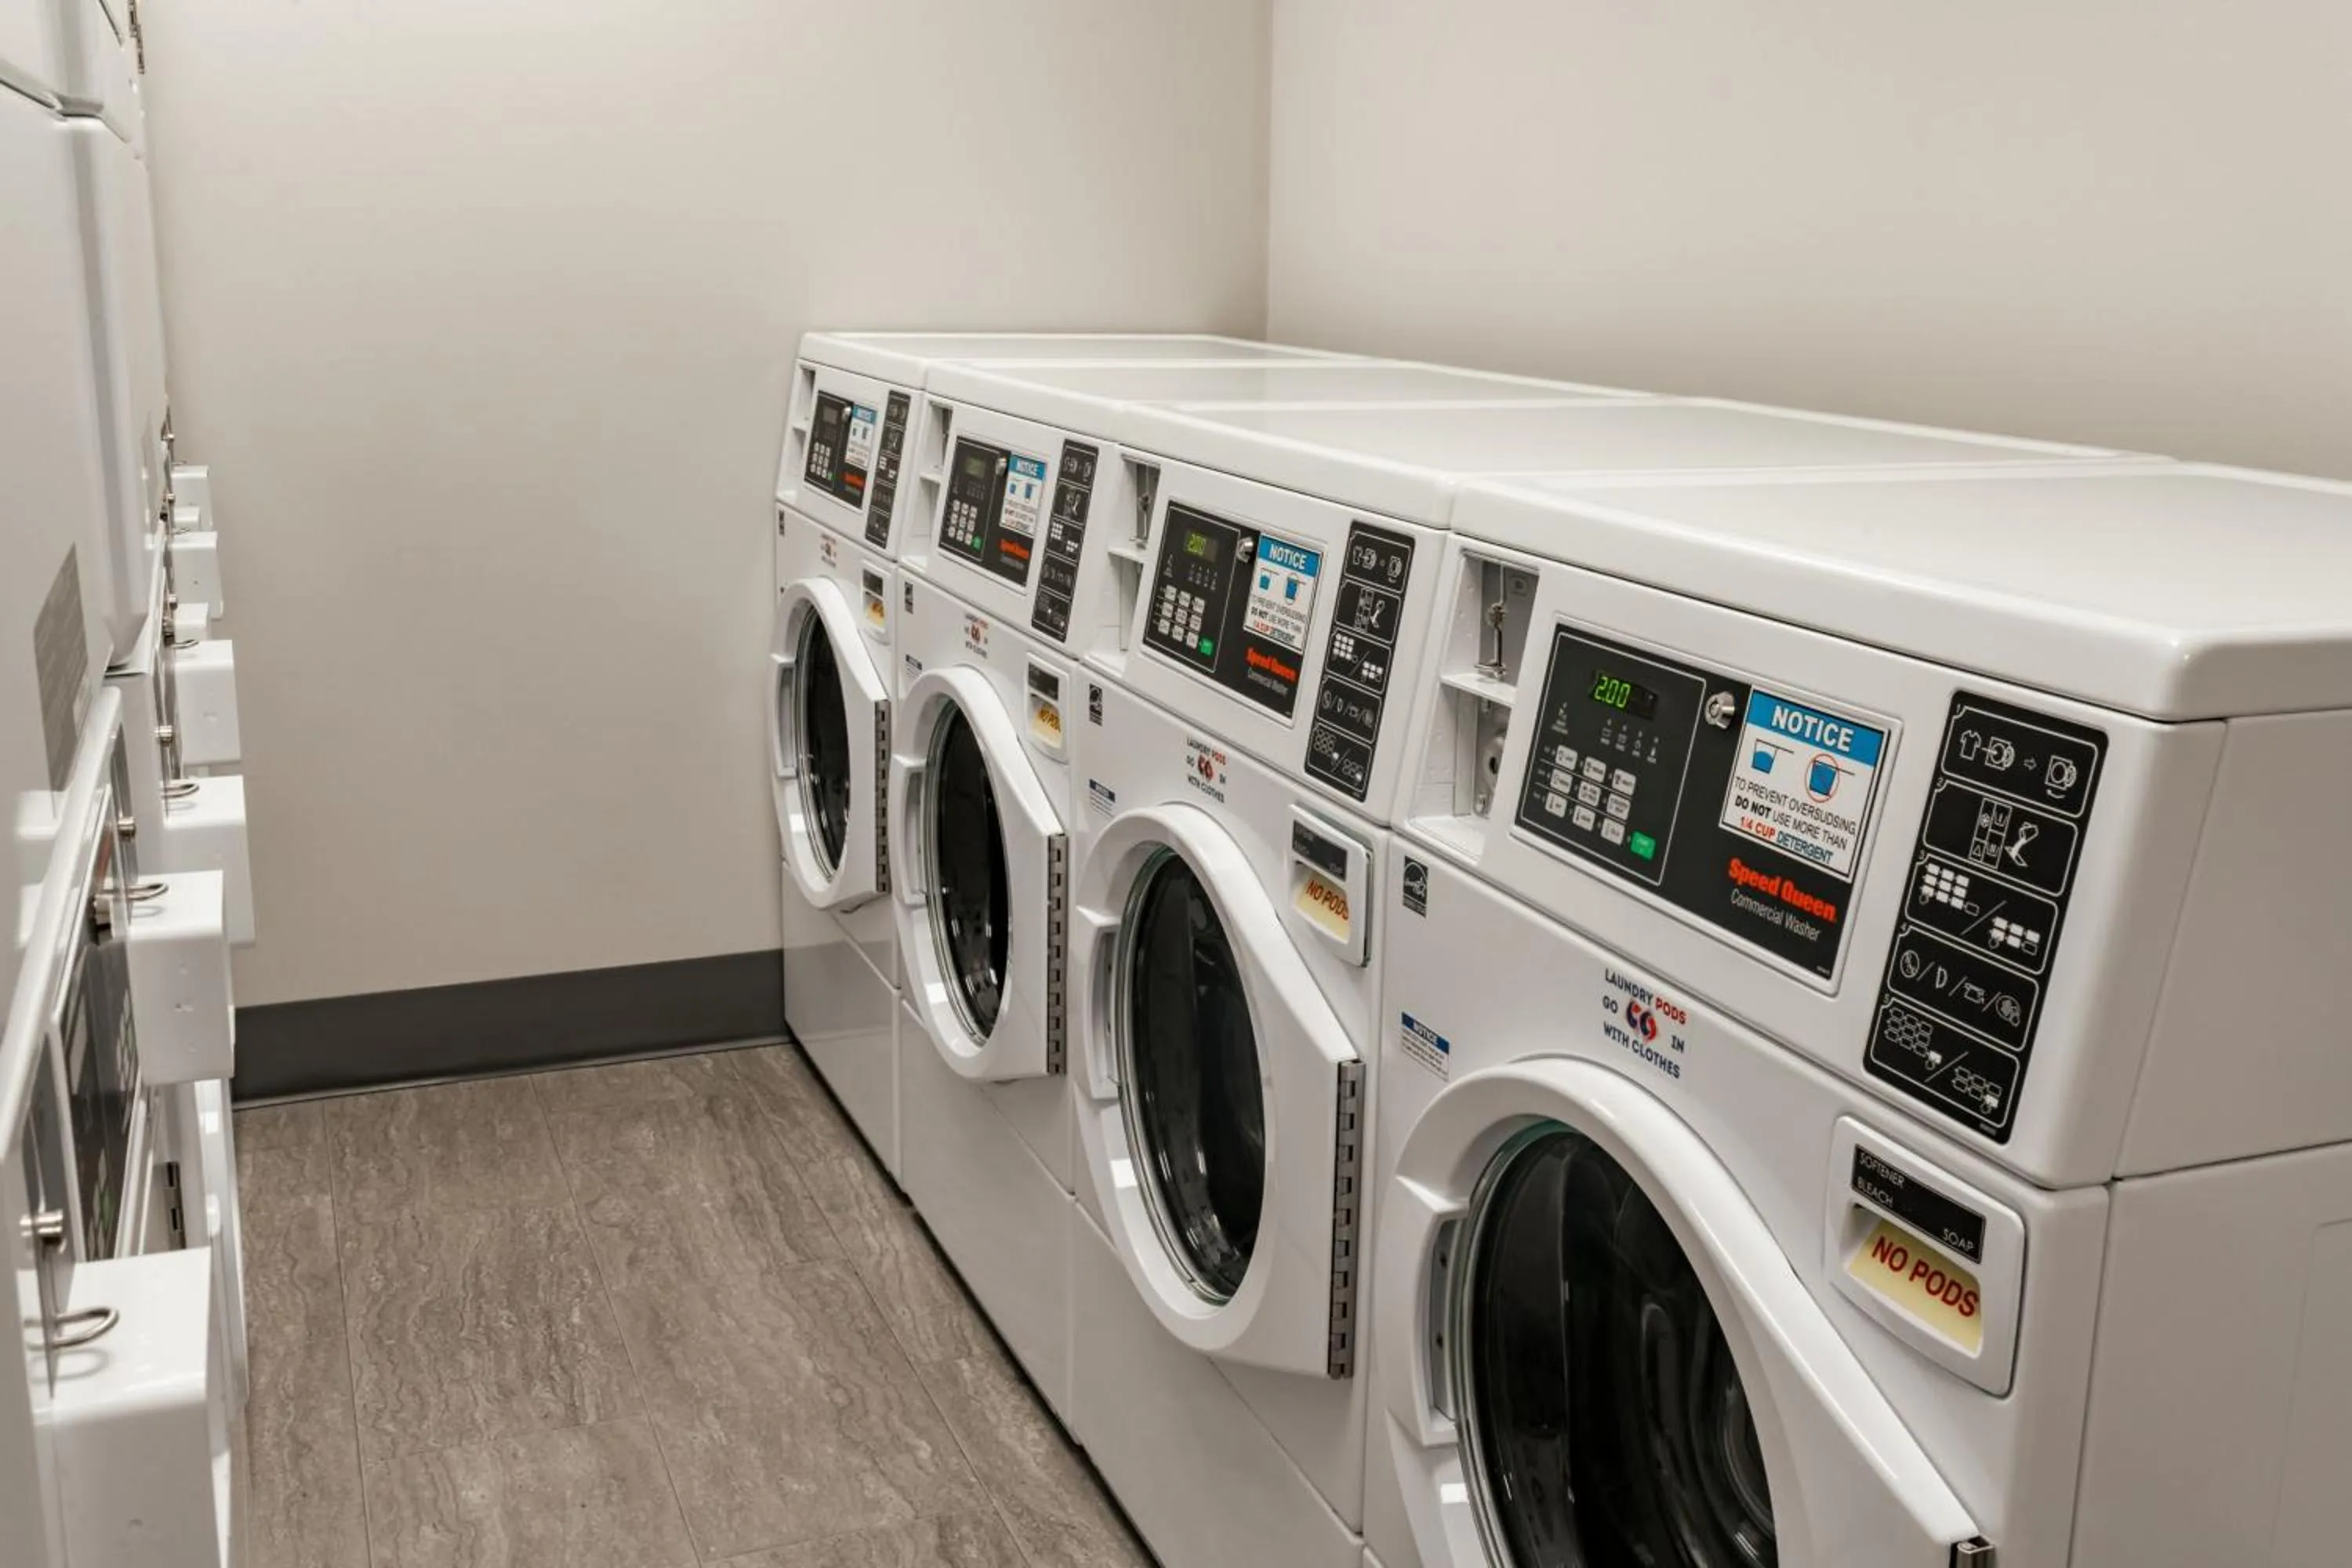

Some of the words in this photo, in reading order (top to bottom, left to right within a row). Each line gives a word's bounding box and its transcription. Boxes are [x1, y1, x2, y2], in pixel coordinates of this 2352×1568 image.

[1269, 543, 1308, 570] NOTICE
[1772, 705, 1854, 753] NOTICE
[1735, 776, 1746, 790] TO
[1748, 782, 1789, 807] PREVENT
[1789, 797, 1857, 836] OVERSUDSING
[1735, 796, 1749, 810] DO
[1751, 800, 1772, 818] NOT
[1773, 808, 1791, 828] USE
[1792, 816, 1823, 840] MORE
[1823, 828, 1849, 851] THAN
[1755, 821, 1777, 840] CUP
[1777, 831, 1835, 864] DETERGENT
[1305, 878, 1324, 901] NO
[1729, 857, 1781, 897] Speed
[1781, 880, 1838, 923] Queen
[1731, 887, 1785, 926] Commercial
[1784, 912, 1821, 942] Washer
[1602, 994, 1618, 1014] GO
[1671, 1034, 1685, 1054] IN
[1606, 967, 1653, 1005] LAUNDRY
[1655, 996, 1686, 1025] PODS
[1603, 1020, 1629, 1048] WITH
[1632, 1039, 1680, 1079] CLOTHES
[1859, 1152, 1905, 1189] SOFTENER
[1857, 1176, 1893, 1208] BLEACH
[1943, 1229, 1973, 1252] SOAP
[1871, 1235, 1908, 1273] NO
[1909, 1259, 1980, 1318] PODS
